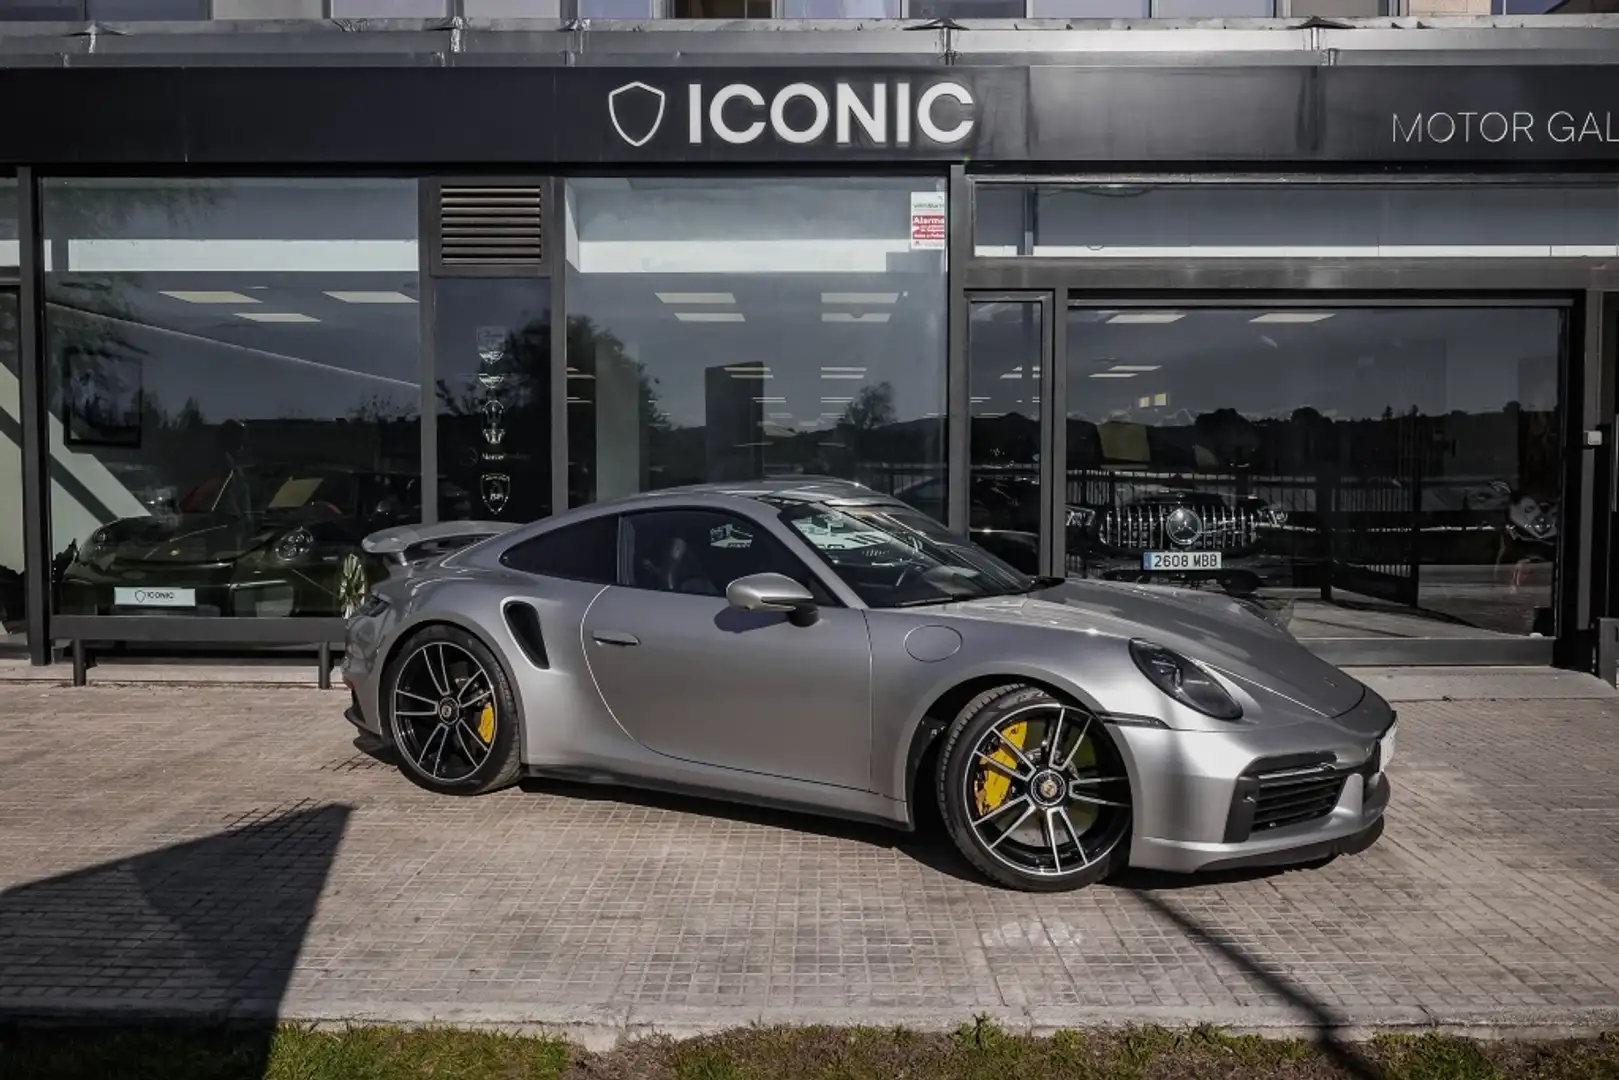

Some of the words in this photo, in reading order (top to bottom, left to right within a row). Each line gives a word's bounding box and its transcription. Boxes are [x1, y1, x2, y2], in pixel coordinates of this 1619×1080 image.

[688, 82, 974, 144] ICONIC
[1392, 111, 1535, 143] MOTOR
[1547, 110, 1619, 143] GAL
[1154, 555, 1189, 568] 2608
[147, 591, 175, 599] ICONIC
